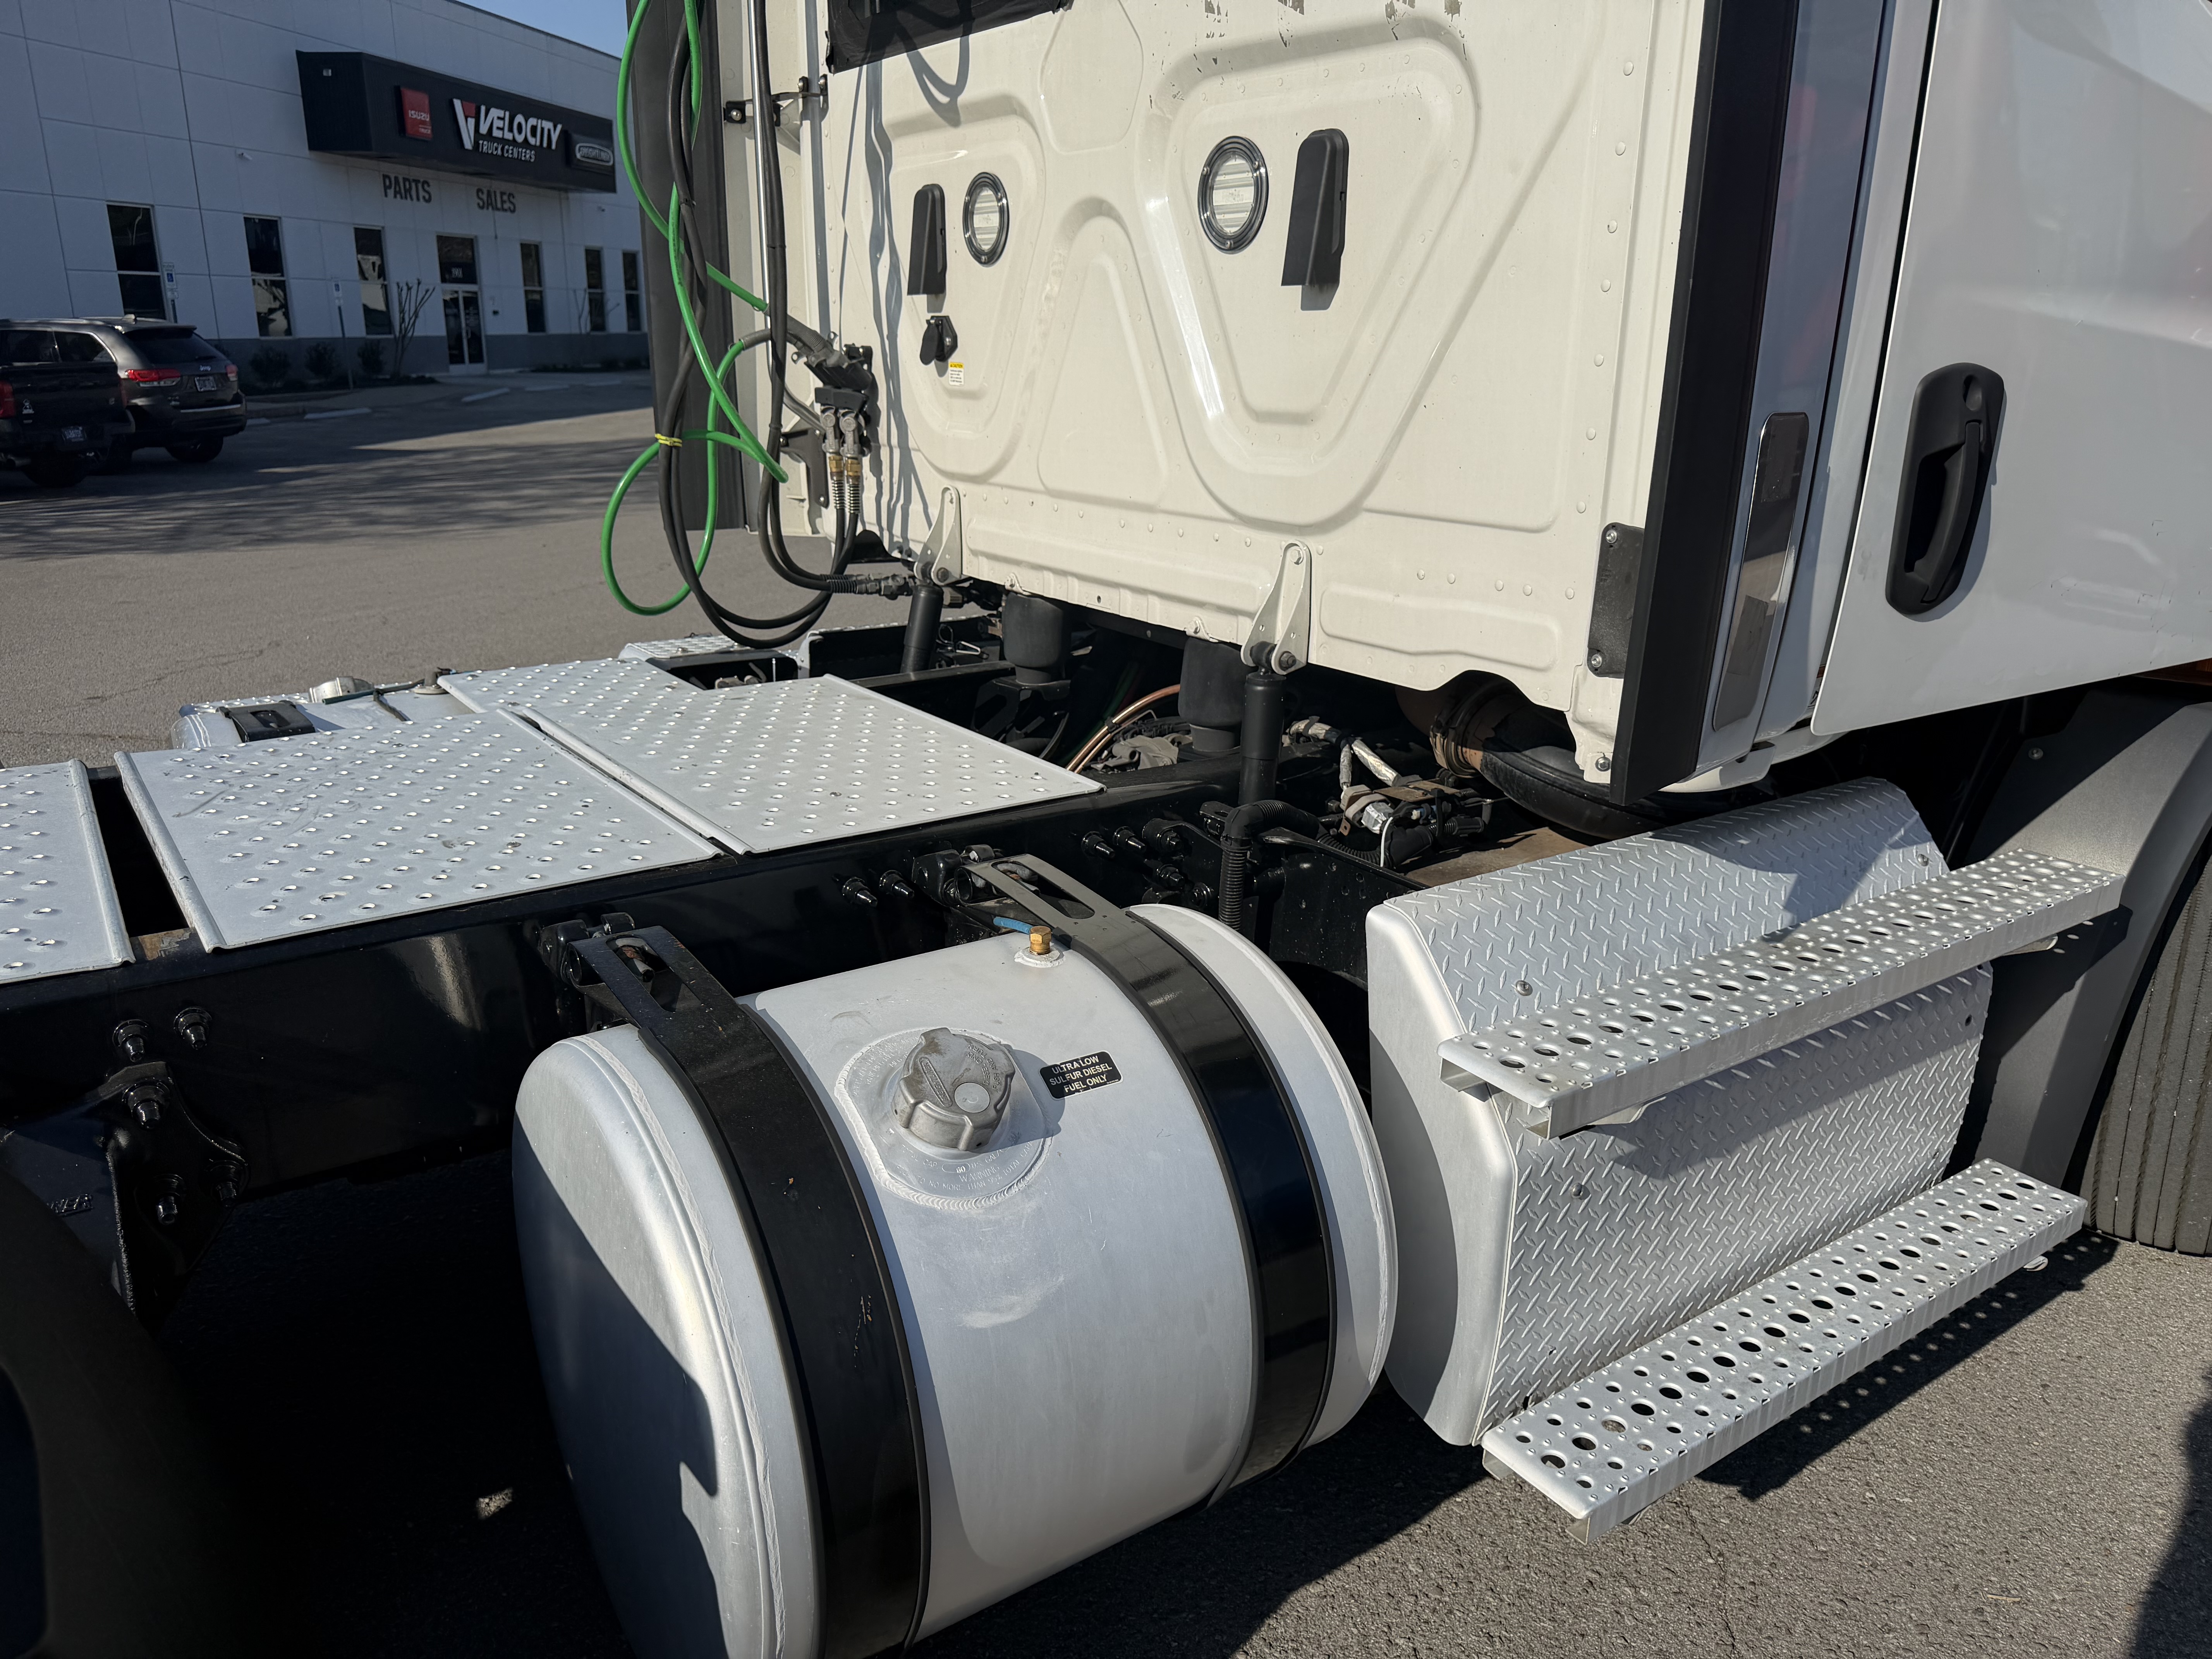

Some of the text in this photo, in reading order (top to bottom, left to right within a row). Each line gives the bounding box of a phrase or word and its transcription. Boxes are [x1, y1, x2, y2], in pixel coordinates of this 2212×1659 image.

[479, 105, 562, 150] VELOCITY
[479, 140, 535, 162] TRUCK CENTERS
[383, 173, 432, 203] PARTS
[476, 188, 516, 213] SALES
[967, 1044, 987, 1058] TURN
[967, 1052, 991, 1085] DIESEL ONLY
[986, 1058, 998, 1070] AND
[1049, 1063, 1113, 1085] SULFUR DIESEL
[1051, 1055, 1099, 1074] ULTRA LOW
[1063, 1081, 1087, 1092] FUEL
[1086, 1074, 1107, 1085] ONLY
[917, 1175, 926, 1184] TO
[967, 1181, 986, 1190] THAN
[959, 1164, 1000, 1182] WARNING
